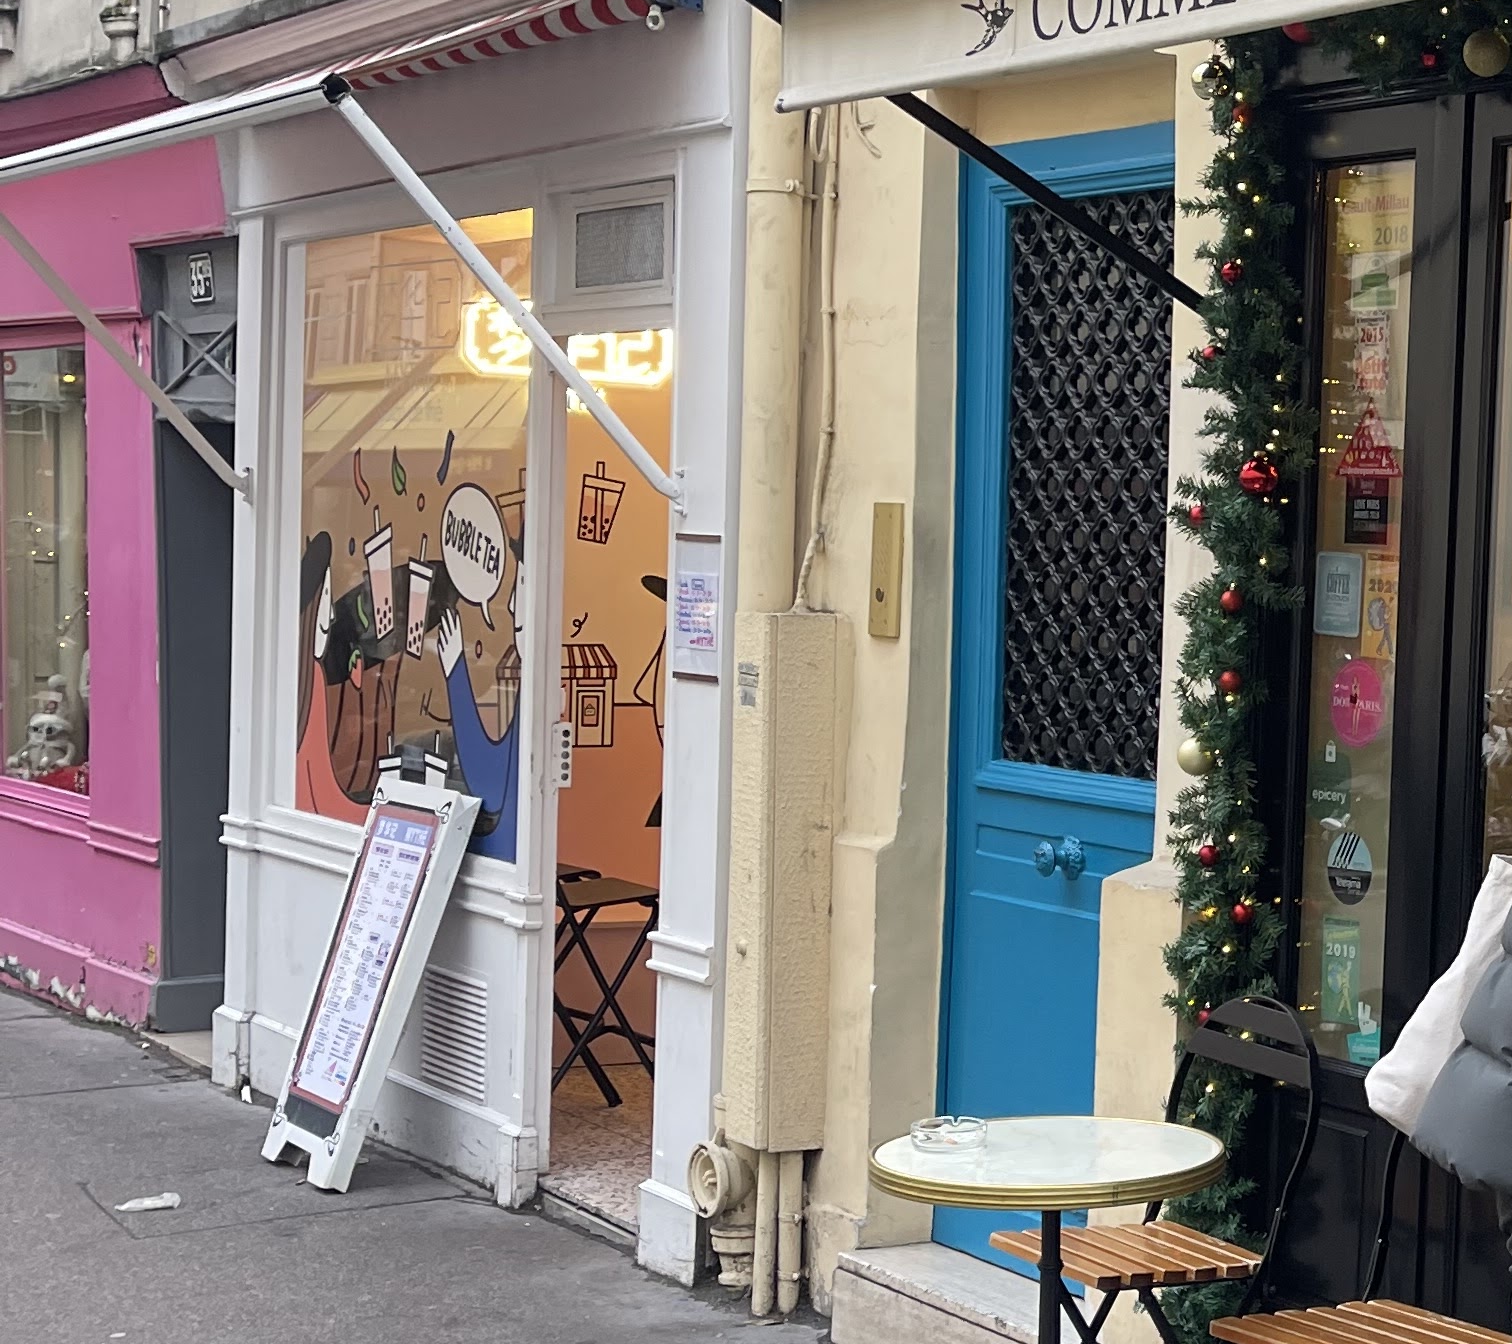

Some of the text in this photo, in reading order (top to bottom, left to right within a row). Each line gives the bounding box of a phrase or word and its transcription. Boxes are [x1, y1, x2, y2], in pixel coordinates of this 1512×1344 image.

[1374, 225, 1409, 245] 2018
[445, 509, 500, 580] BUBBLE TEA
[1311, 788, 1347, 805] epicery
[1325, 942, 1356, 959] 2019
